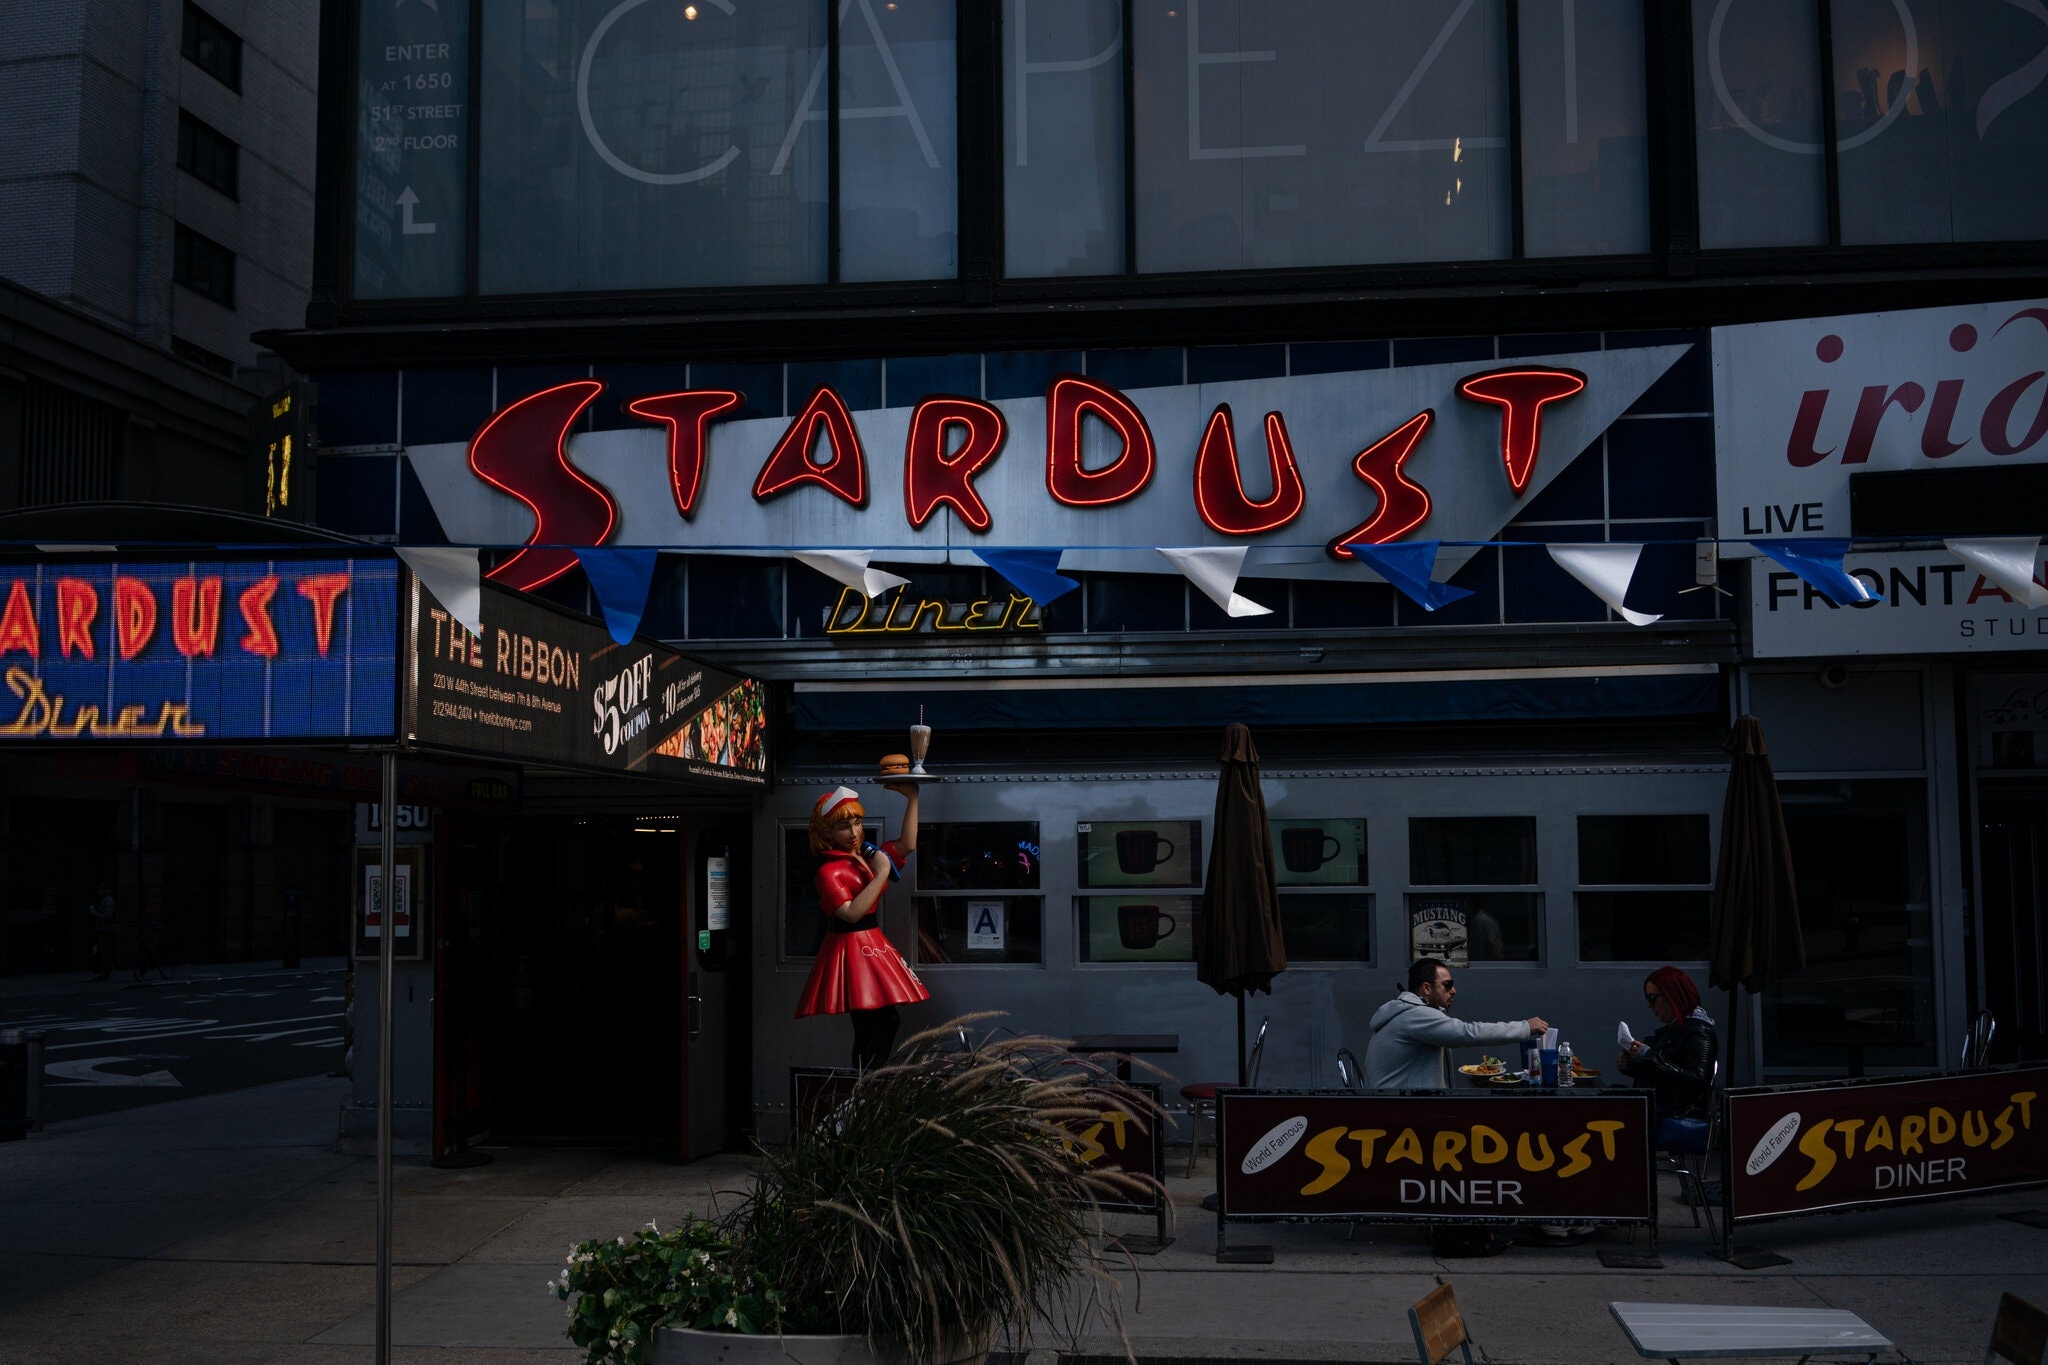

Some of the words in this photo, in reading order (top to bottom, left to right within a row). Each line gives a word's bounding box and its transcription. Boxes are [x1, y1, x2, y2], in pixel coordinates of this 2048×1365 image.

[385, 43, 450, 61] ENTER
[381, 80, 397, 91] AT
[403, 73, 452, 90] 1650
[407, 104, 463, 120] STREET
[375, 136, 400, 151] 2ND
[404, 135, 458, 150] FLOOR
[466, 365, 1588, 592] STARDUST
[1743, 503, 1824, 534] LIVE
[0, 572, 352, 661] ARDUST
[824, 583, 1040, 634] Diner
[430, 607, 485, 668] THE
[496, 628, 580, 692] RIBBON
[0, 665, 206, 736] Diner
[433, 673, 446, 689] 220
[446, 675, 454, 691] W
[455, 677, 470, 694] 44th
[470, 681, 488, 699] Street
[489, 685, 516, 704] between
[542, 697, 562, 714] Avenue
[594, 673, 620, 755] $5
[620, 653, 653, 715] OFF
[620, 706, 651, 746] COUPON
[216, 749, 334, 785] SINGING
[404, 774, 461, 799] STAFF
[370, 802, 430, 828] 150
[974, 908, 997, 934] A
[1413, 907, 1467, 926] MUSTANG
[1245, 1146, 1272, 1170] World
[1269, 1121, 1304, 1152] Famous
[1300, 1120, 1625, 1196] STARDUST
[1749, 1145, 1772, 1171] World
[1769, 1117, 1798, 1149] Famous
[1795, 1091, 2038, 1192] STARDUST
[1400, 1178, 1524, 1206] DINER
[1874, 1157, 1968, 1191] DINER
